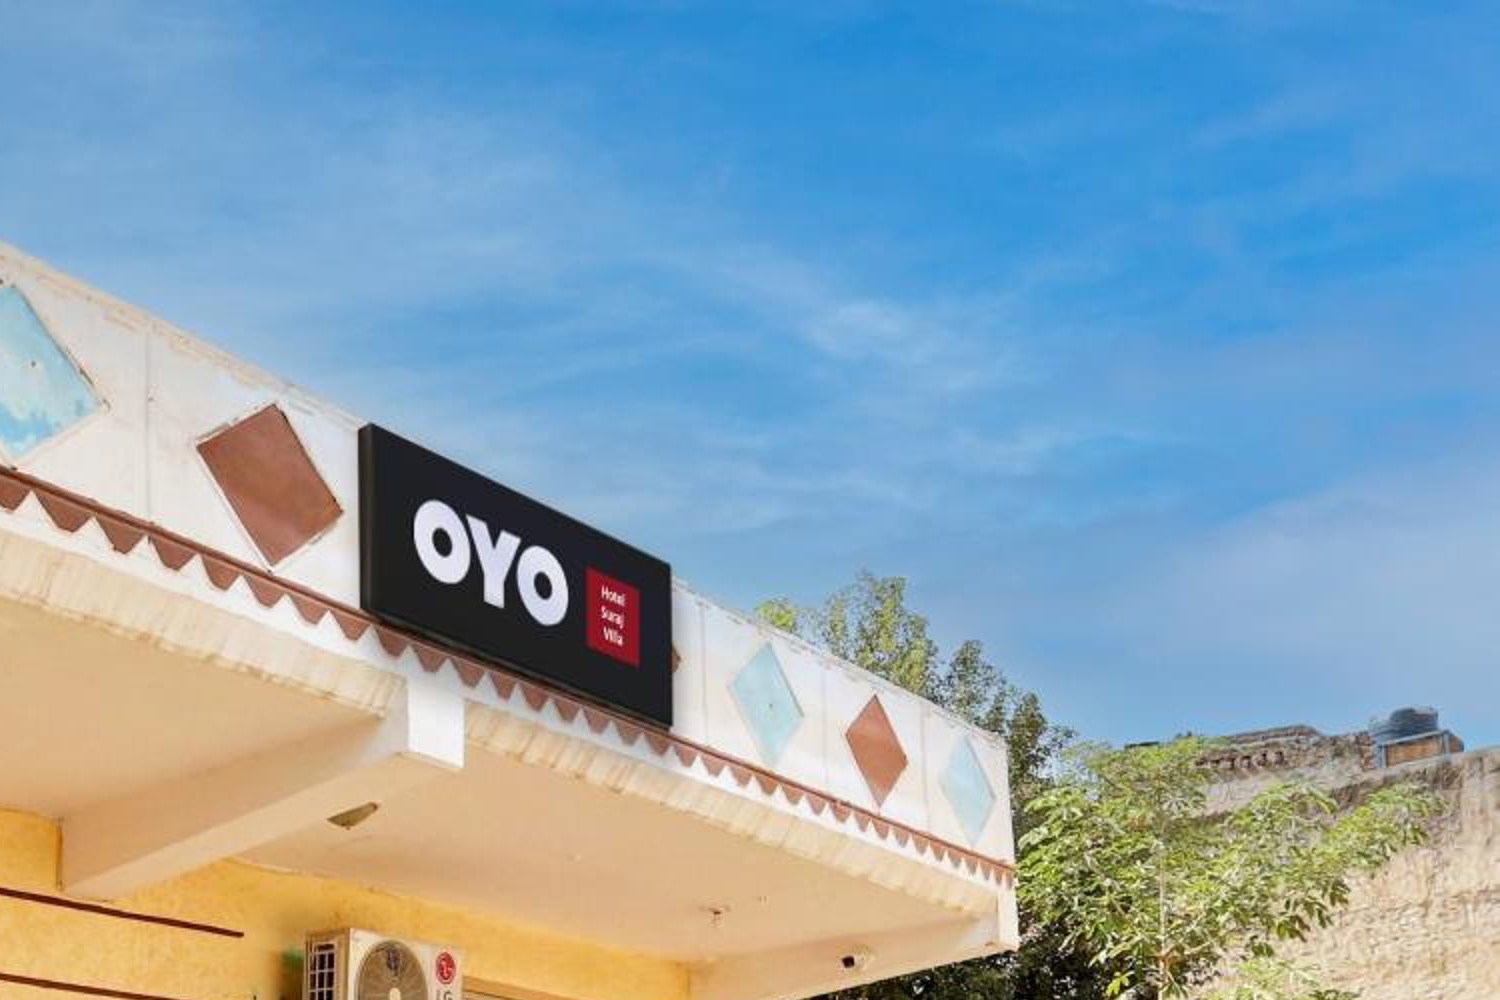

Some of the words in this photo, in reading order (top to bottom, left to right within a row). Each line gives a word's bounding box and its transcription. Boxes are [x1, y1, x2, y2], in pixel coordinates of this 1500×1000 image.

[413, 499, 569, 627] OYO
[601, 585, 626, 607] Hotel
[601, 605, 625, 629] Suraj
